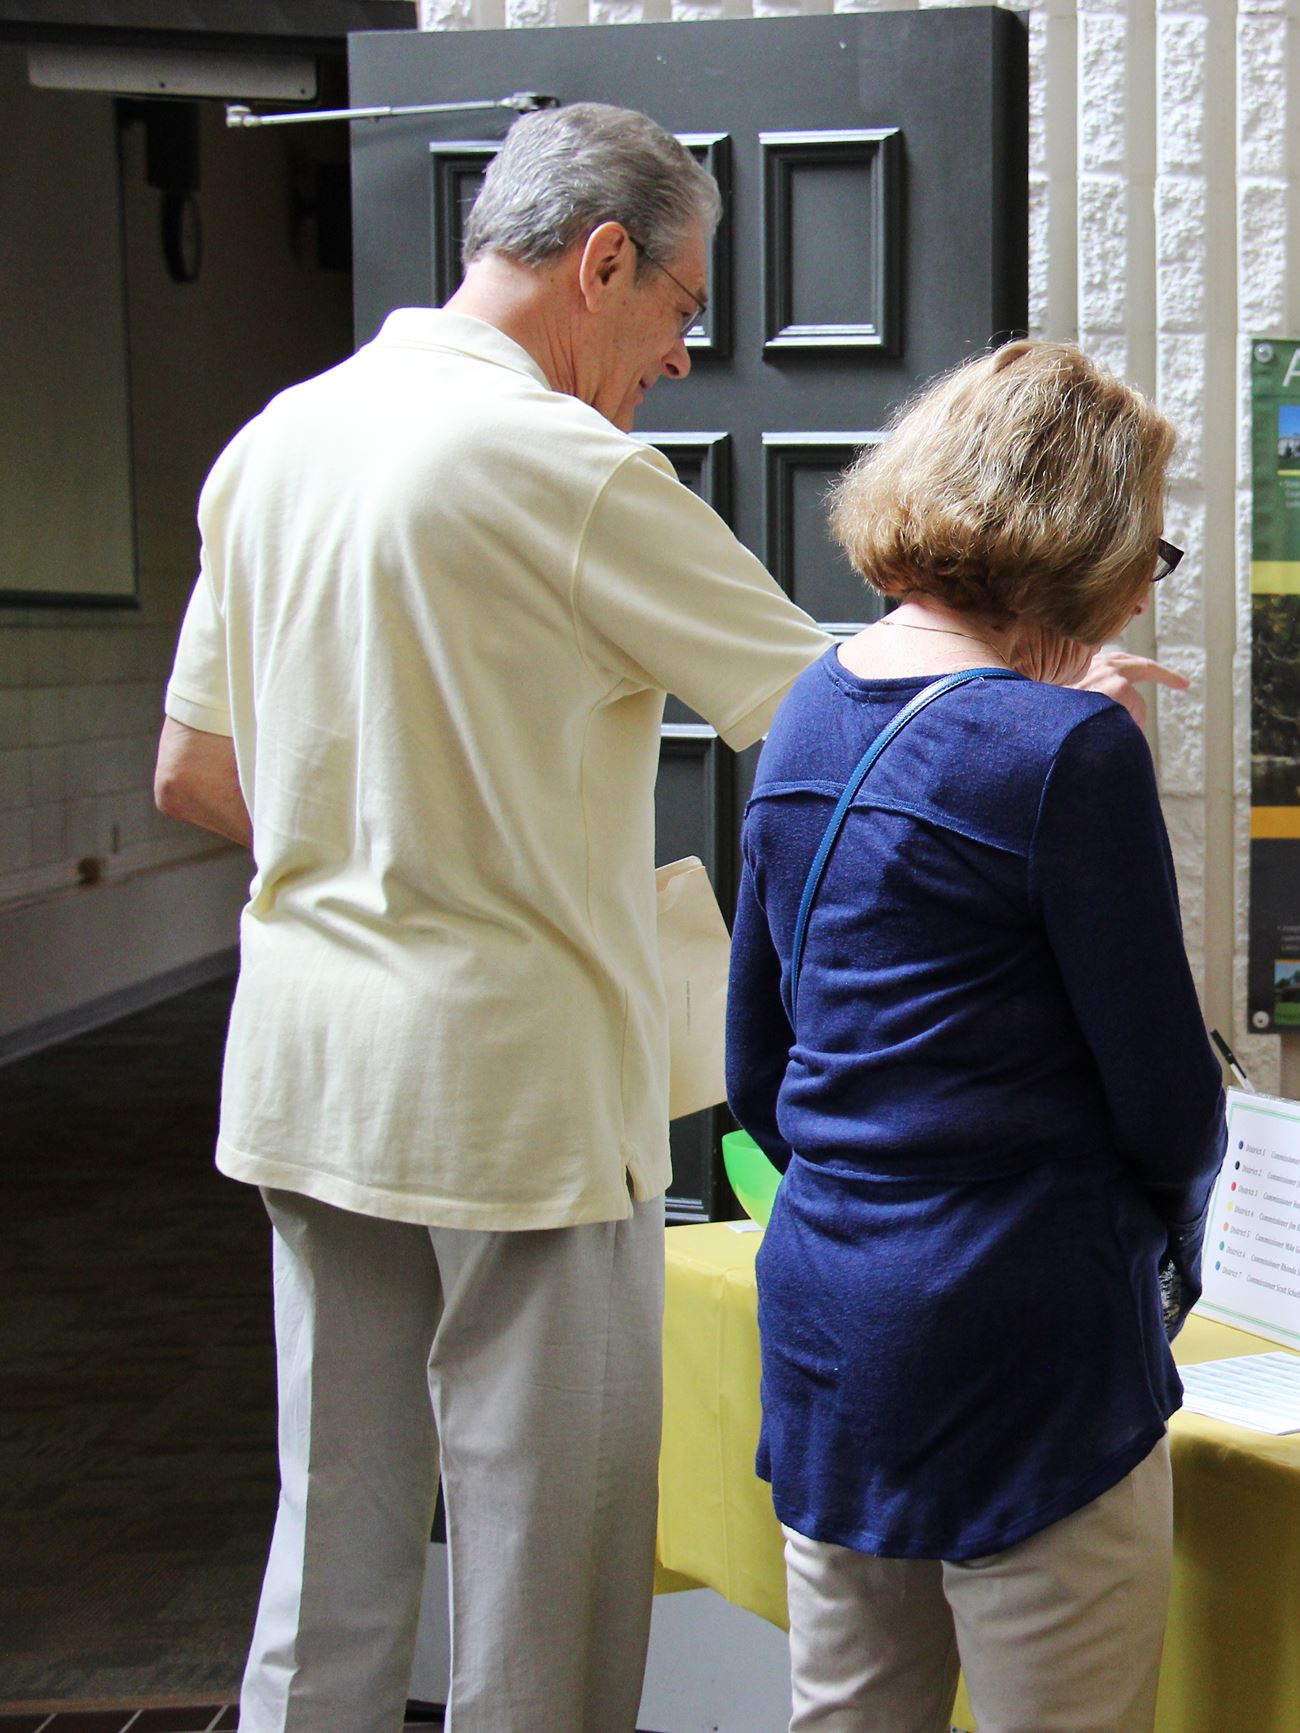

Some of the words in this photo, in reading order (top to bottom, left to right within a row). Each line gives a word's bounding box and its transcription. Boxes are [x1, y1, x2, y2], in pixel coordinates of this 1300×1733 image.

[1246, 1144, 1262, 1155] District
[1242, 1165, 1258, 1175] District
[1238, 1185, 1254, 1196] District
[1234, 1206, 1250, 1216] District
[1230, 1226, 1246, 1236] District
[1226, 1246, 1242, 1257] District
[1222, 1267, 1238, 1277] District
